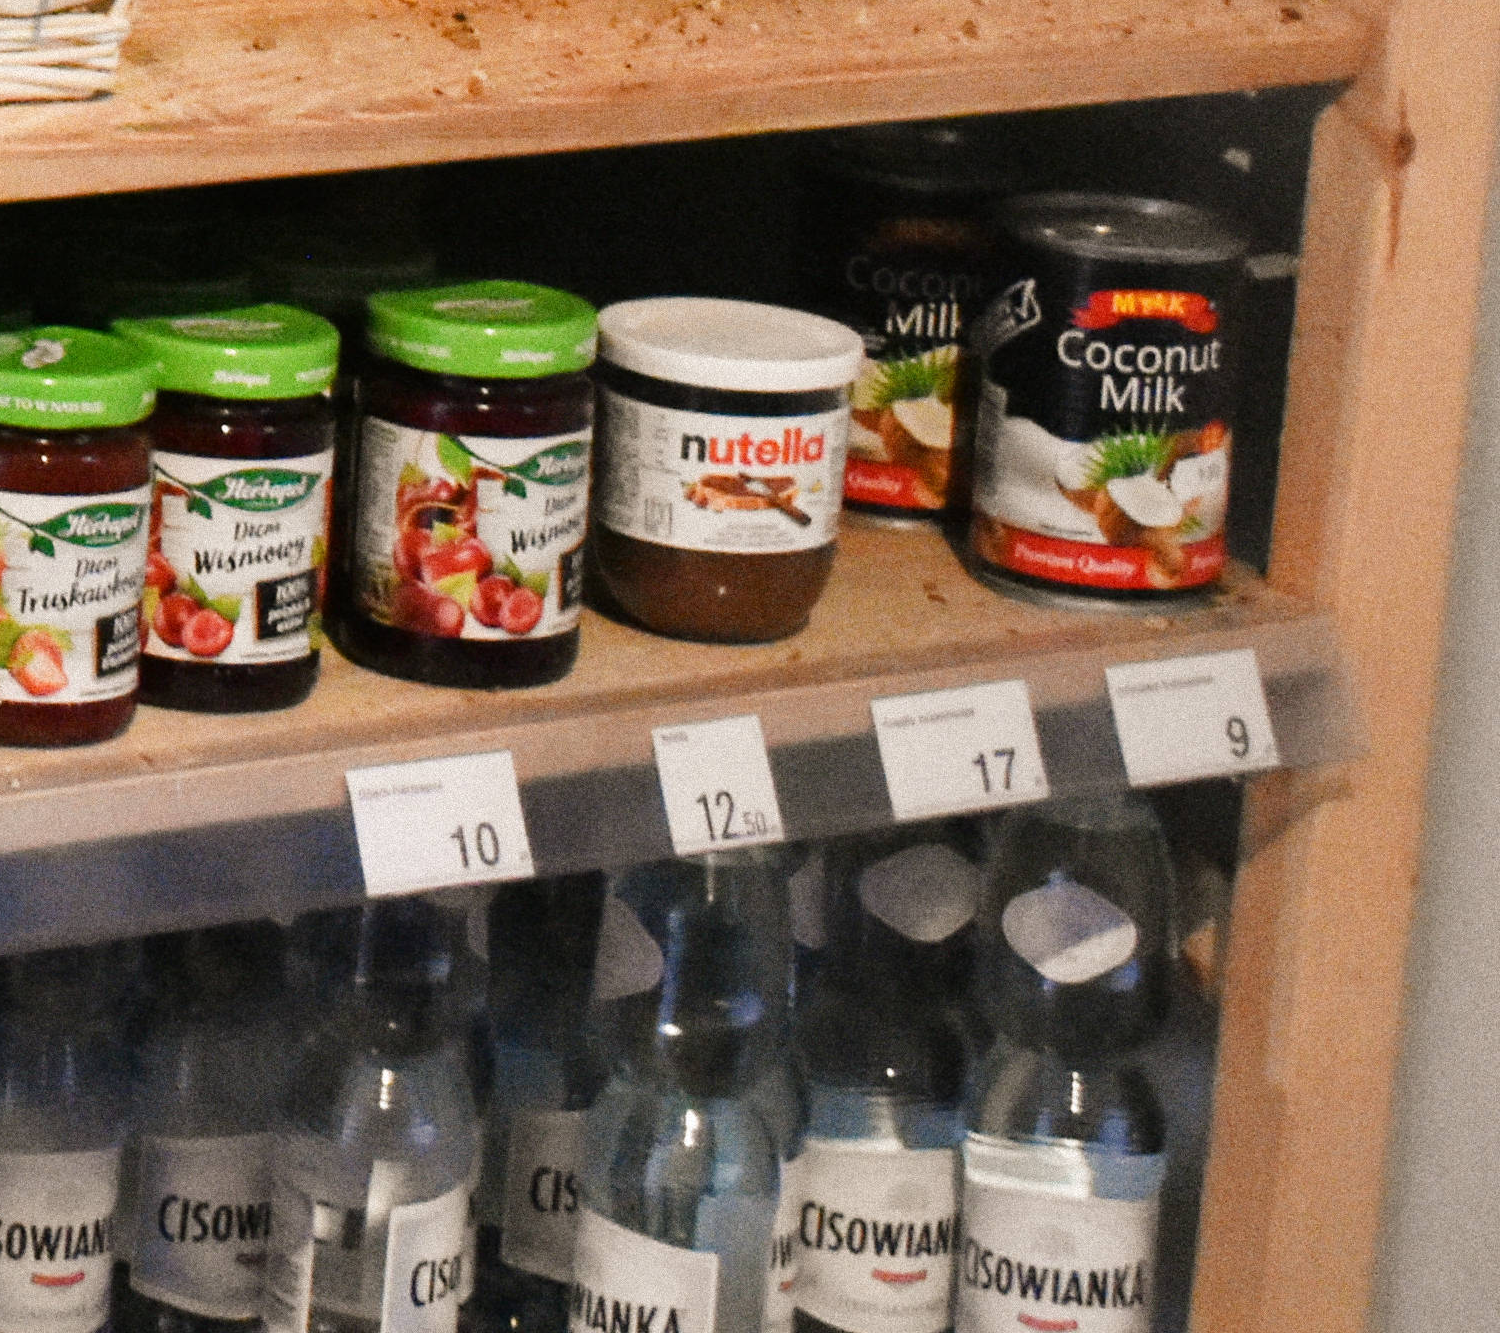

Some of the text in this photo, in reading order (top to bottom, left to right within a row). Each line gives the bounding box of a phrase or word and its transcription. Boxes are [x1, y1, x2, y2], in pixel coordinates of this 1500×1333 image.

[1056, 329, 1223, 375] Coconut
[1100, 375, 1187, 414] Milk
[680, 427, 826, 466] nutella
[1224, 715, 1251, 760] 9
[972, 746, 1017, 794] 17
[449, 820, 501, 870] 10
[799, 1200, 955, 1259] CISOWIAN
